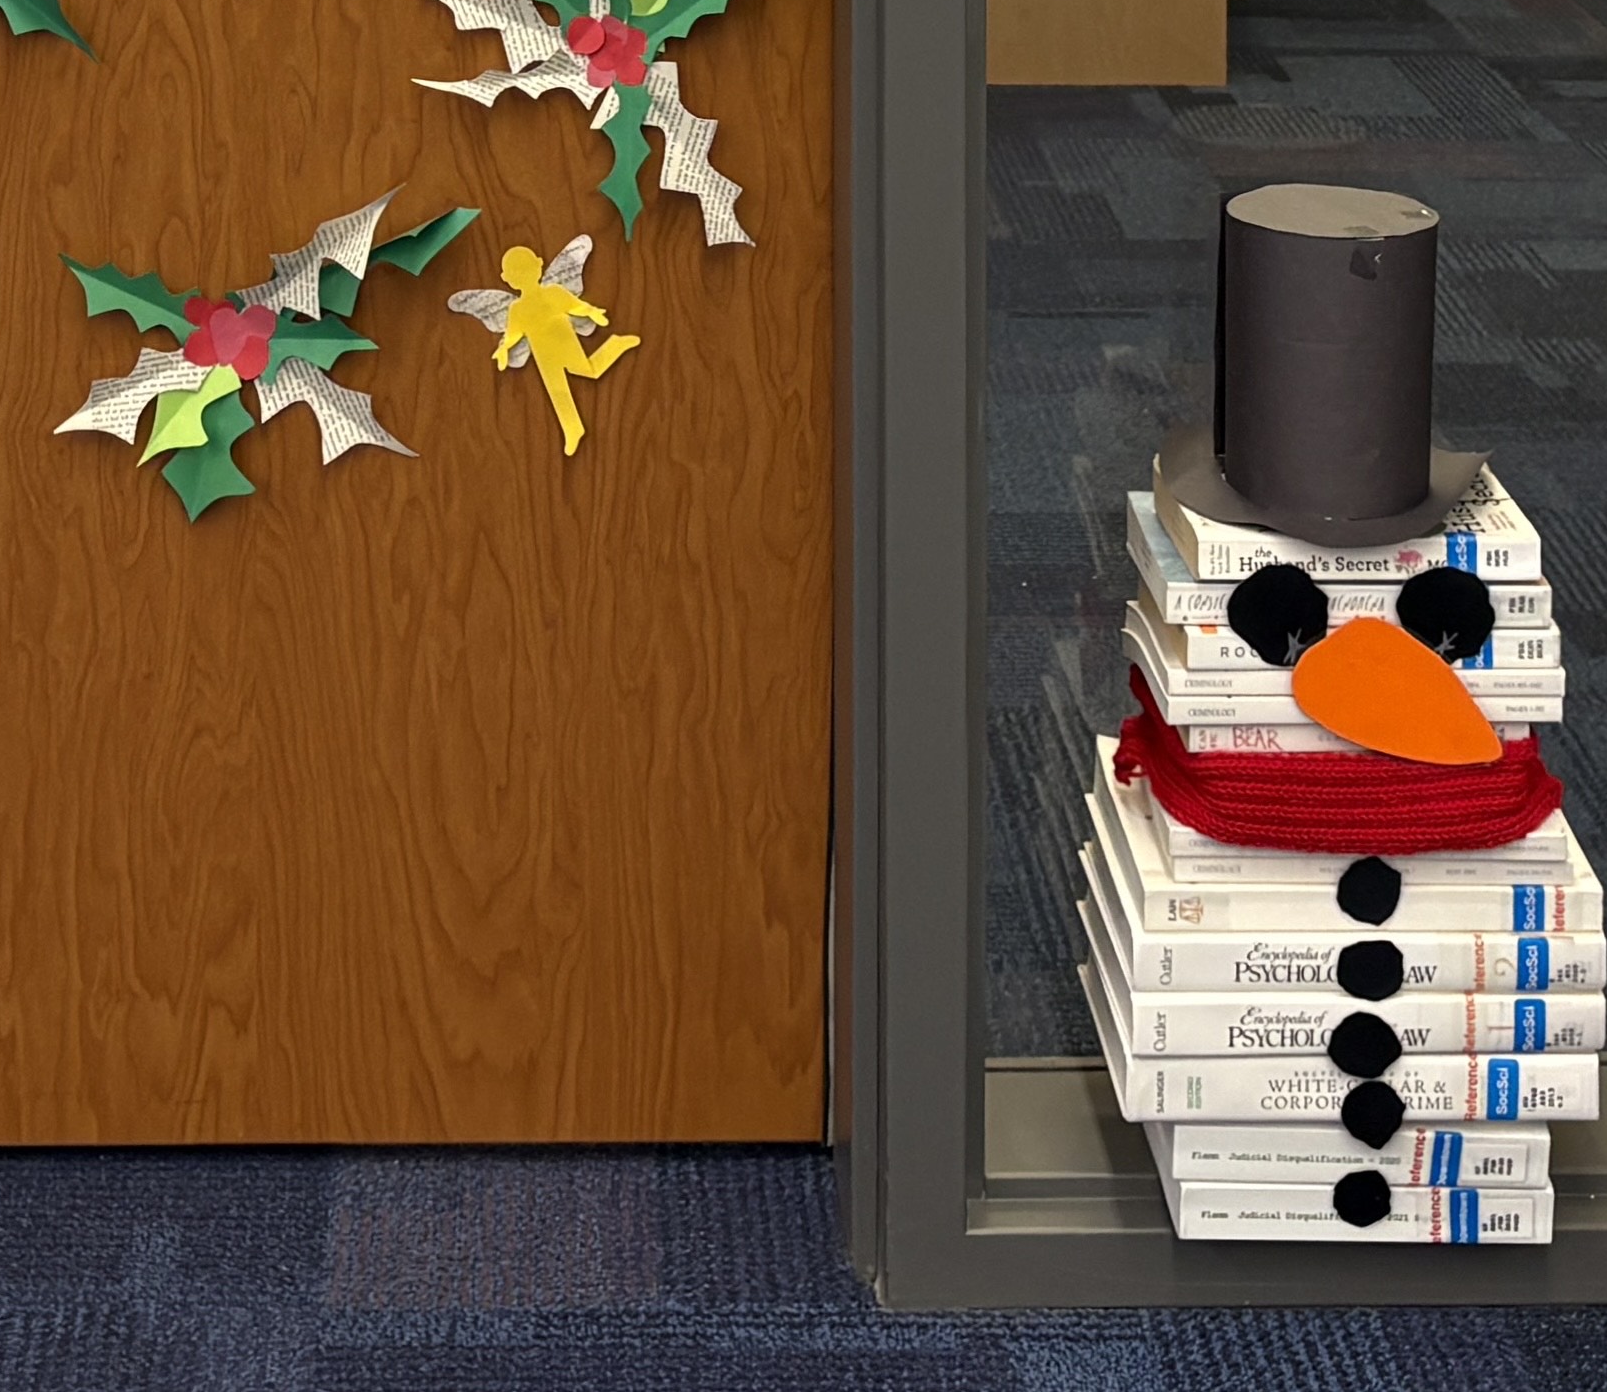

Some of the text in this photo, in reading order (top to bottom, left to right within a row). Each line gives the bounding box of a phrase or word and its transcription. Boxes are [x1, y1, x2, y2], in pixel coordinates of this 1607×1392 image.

[1254, 545, 1273, 558] the
[1334, 555, 1389, 573] Secret
[1232, 726, 1283, 751] BEAR
[1168, 899, 1177, 921] LAW
[1246, 942, 1335, 963] Encyclopedia of
[1159, 945, 1173, 986] Cutler
[1404, 965, 1438, 984] AW
[1240, 1006, 1329, 1028] Encyclopedia of
[1153, 1010, 1167, 1052] Cutler
[1399, 1028, 1431, 1047] AW
[1156, 1070, 1165, 1114] SALINGER
[1433, 1081, 1447, 1093] &
[1495, 1066, 1509, 1115] SocSci
[1260, 1095, 1454, 1110] CORPOR RIME
[1228, 1152, 1271, 1162] Judicial
[1276, 1153, 1364, 1165] Disqualification
[1238, 1211, 1281, 1220] Judicial
[1429, 1186, 1442, 1243] eference
